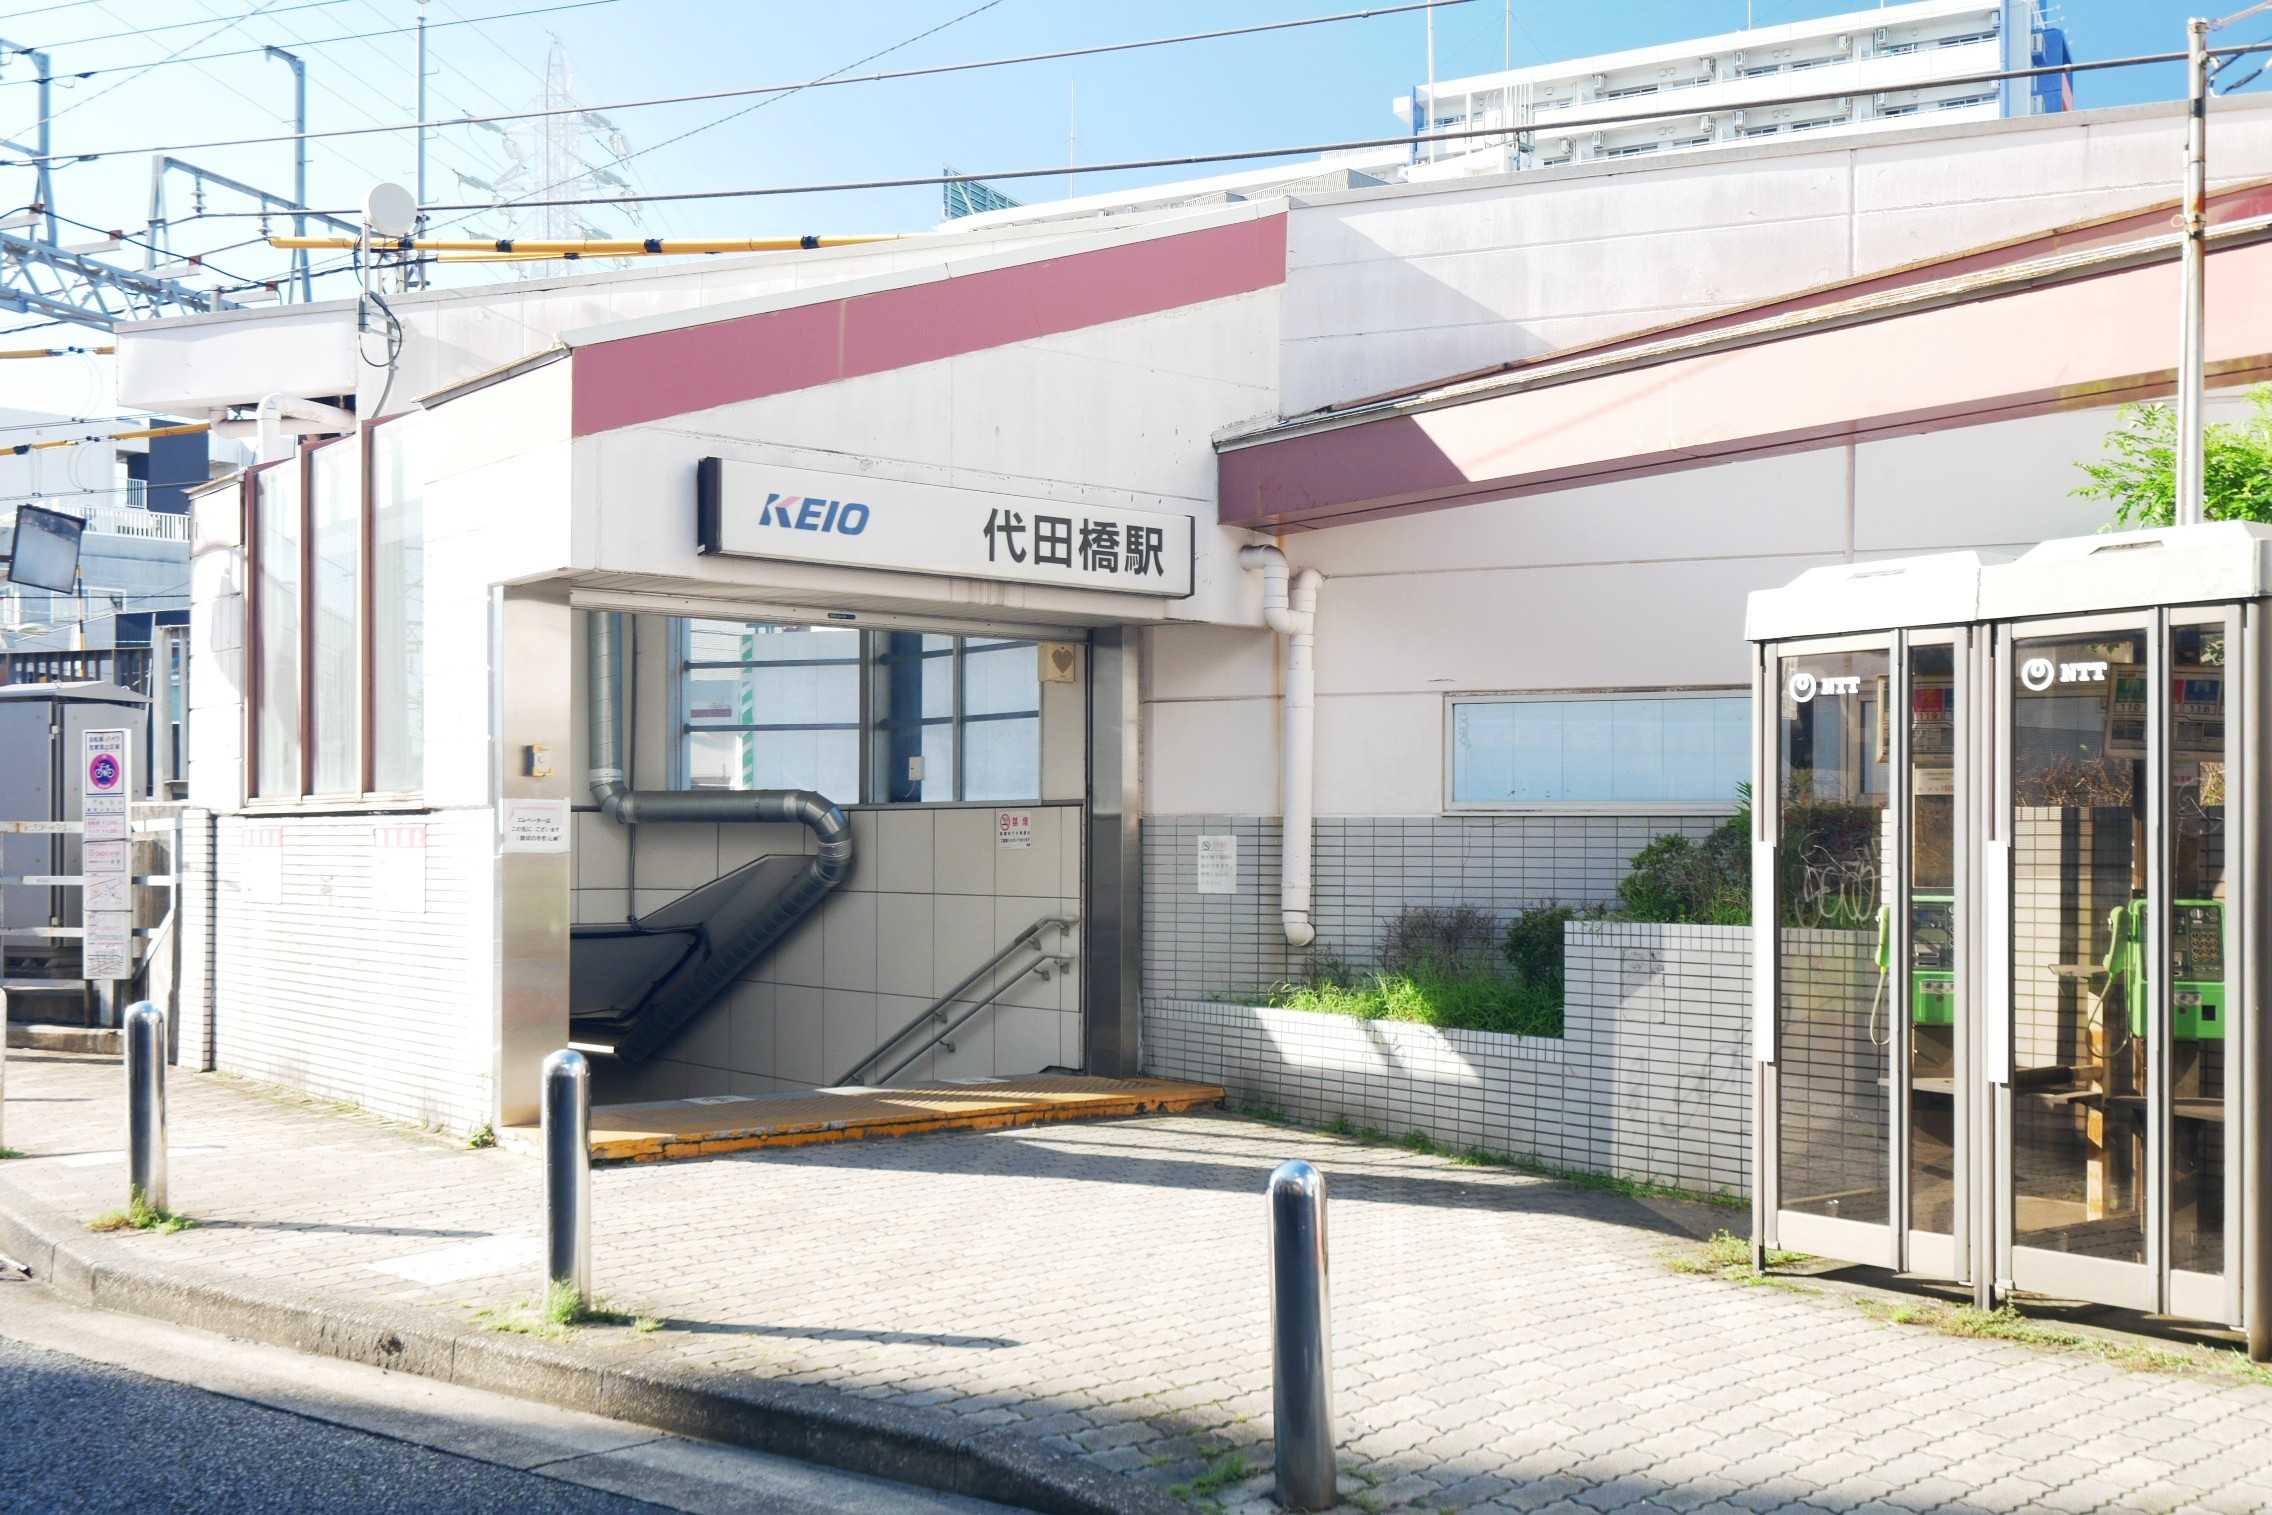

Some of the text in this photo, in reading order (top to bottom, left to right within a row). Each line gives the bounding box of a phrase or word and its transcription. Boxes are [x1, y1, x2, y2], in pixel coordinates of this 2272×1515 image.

[758, 493, 870, 535] KEIO
[983, 508, 1164, 577] 代田橋駅
[2060, 661, 2107, 682] NTT
[1821, 676, 1860, 695] NTT
[1919, 712, 1938, 720] 119
